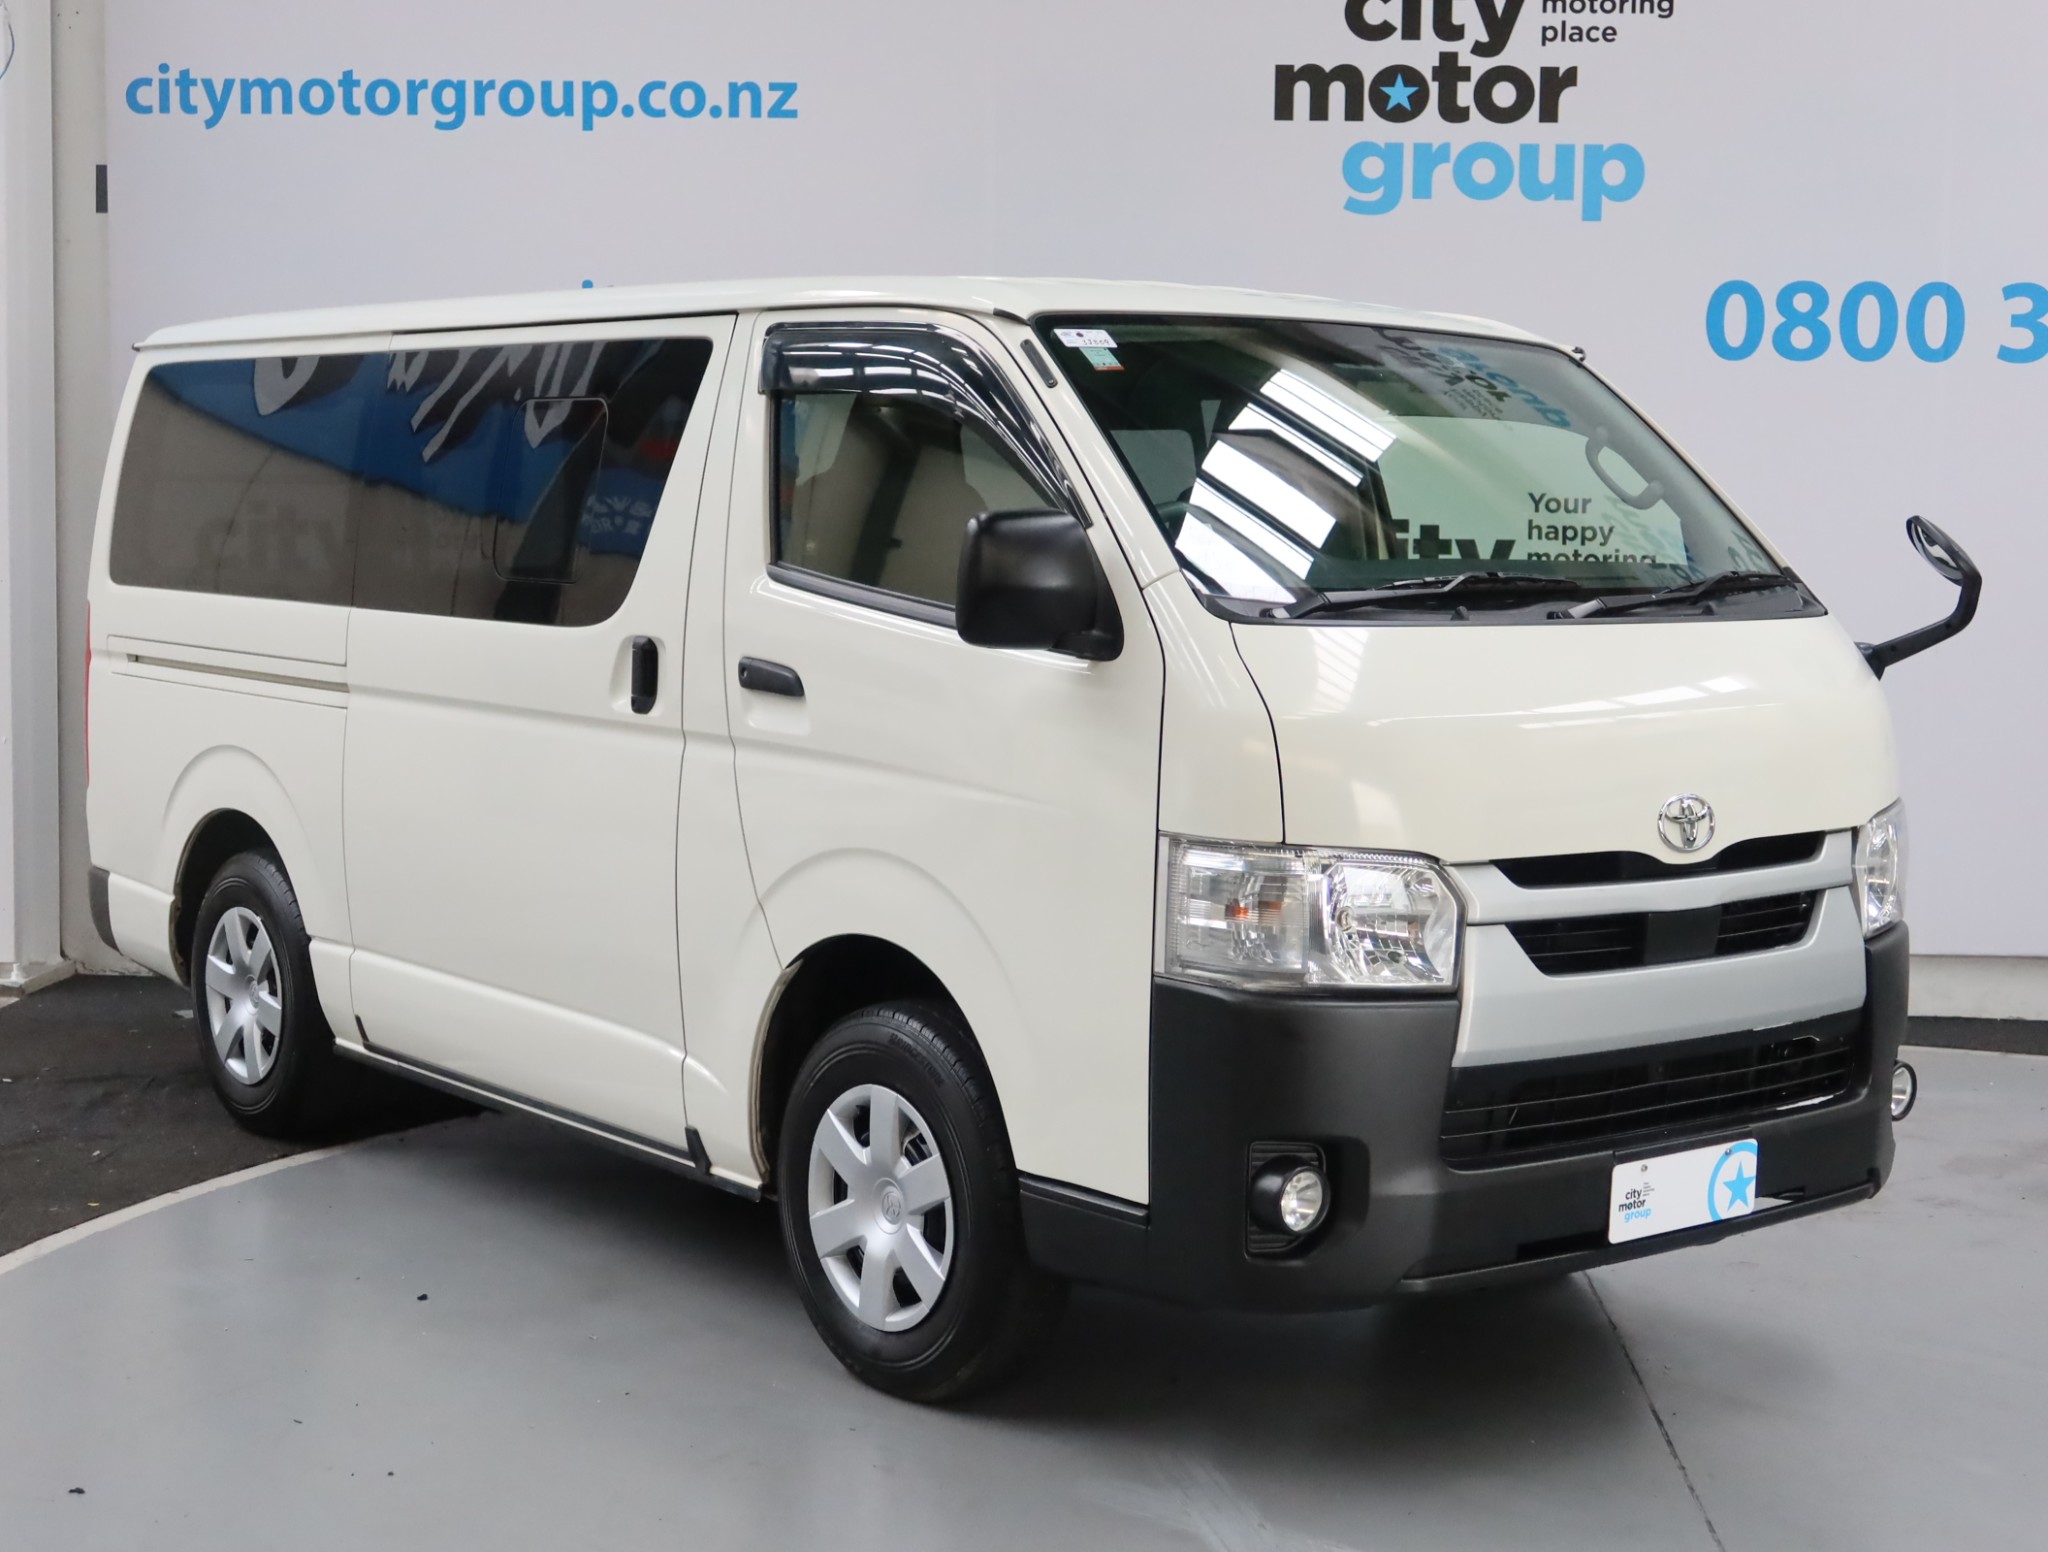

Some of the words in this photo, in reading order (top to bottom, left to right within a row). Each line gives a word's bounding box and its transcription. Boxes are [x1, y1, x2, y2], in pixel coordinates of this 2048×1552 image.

[1542, 0, 1674, 19] motoring
[1345, 0, 1524, 57] city
[1541, 20, 1618, 47] place
[126, 63, 799, 131] citymotorgroup.co.nz
[1273, 51, 1578, 124] motor
[1341, 140, 1646, 222] group
[1706, 280, 1966, 363] 0800
[1528, 492, 1592, 514] Your
[1527, 519, 1615, 547] happy
[1618, 1199, 1646, 1212] motor
[1625, 1189, 1642, 1200] city
[1624, 1207, 1652, 1223] group
